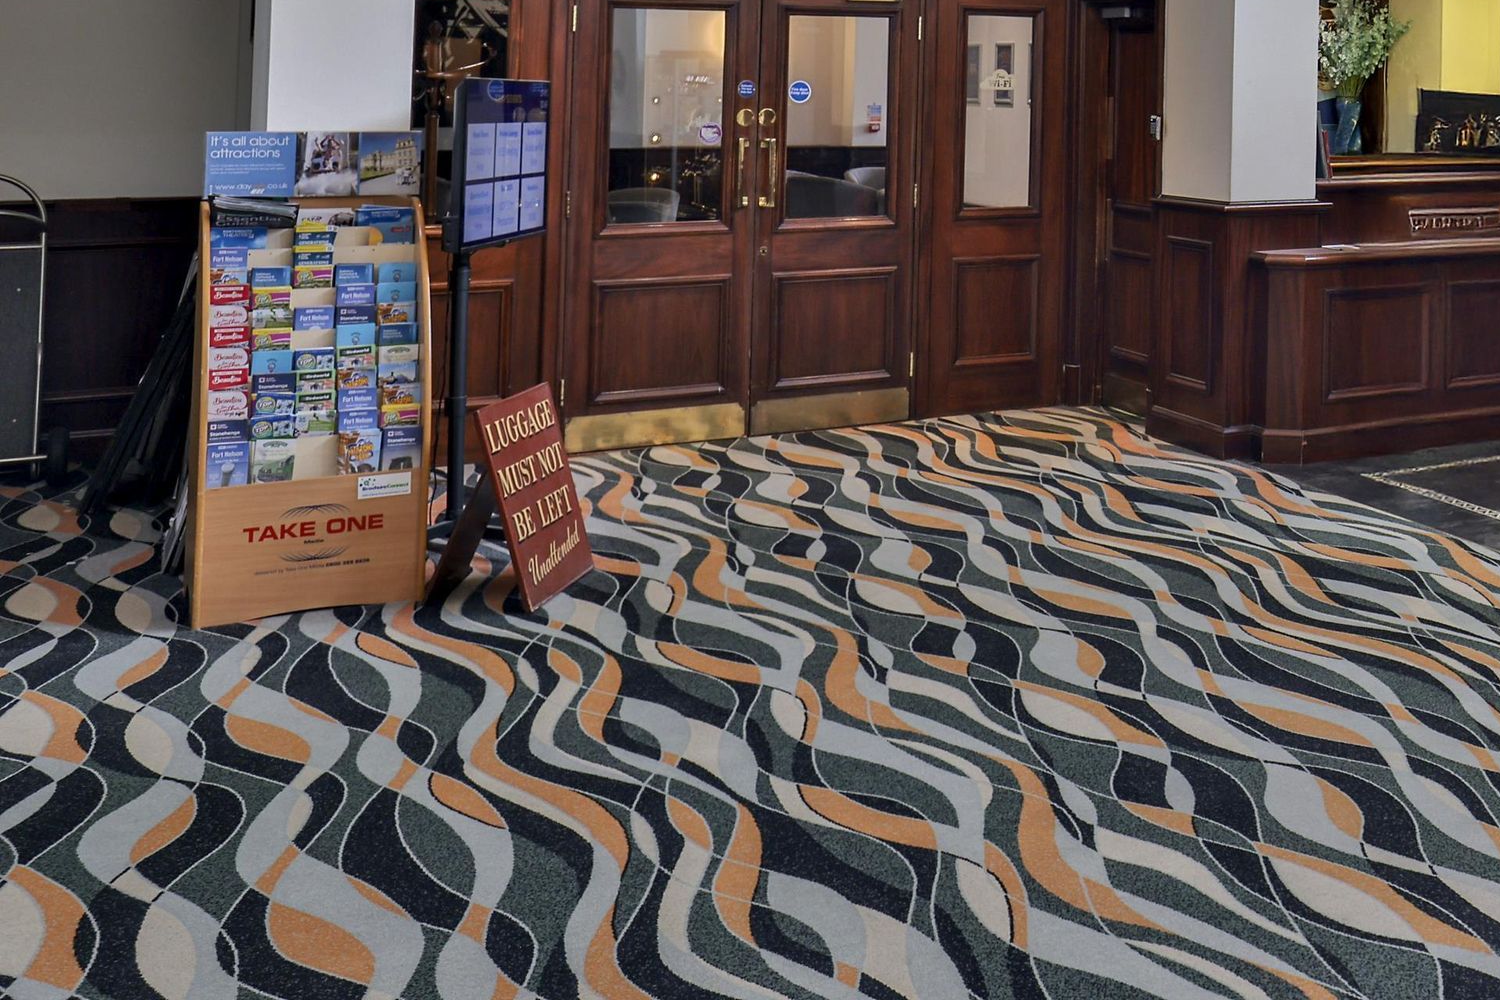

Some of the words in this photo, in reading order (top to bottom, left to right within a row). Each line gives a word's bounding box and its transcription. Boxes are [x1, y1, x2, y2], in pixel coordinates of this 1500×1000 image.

[210, 135, 229, 147] It's
[231, 135, 246, 146] all
[249, 136, 290, 146] about
[210, 148, 281, 159] attractions
[485, 399, 555, 454] LUGGAGE
[496, 456, 538, 499] MUST
[535, 441, 565, 479] NOT
[243, 521, 316, 543] TAKE
[326, 513, 384, 535] ONE
[511, 507, 537, 543] BE
[536, 484, 573, 528] LEFT
[528, 519, 580, 585] Unattended
